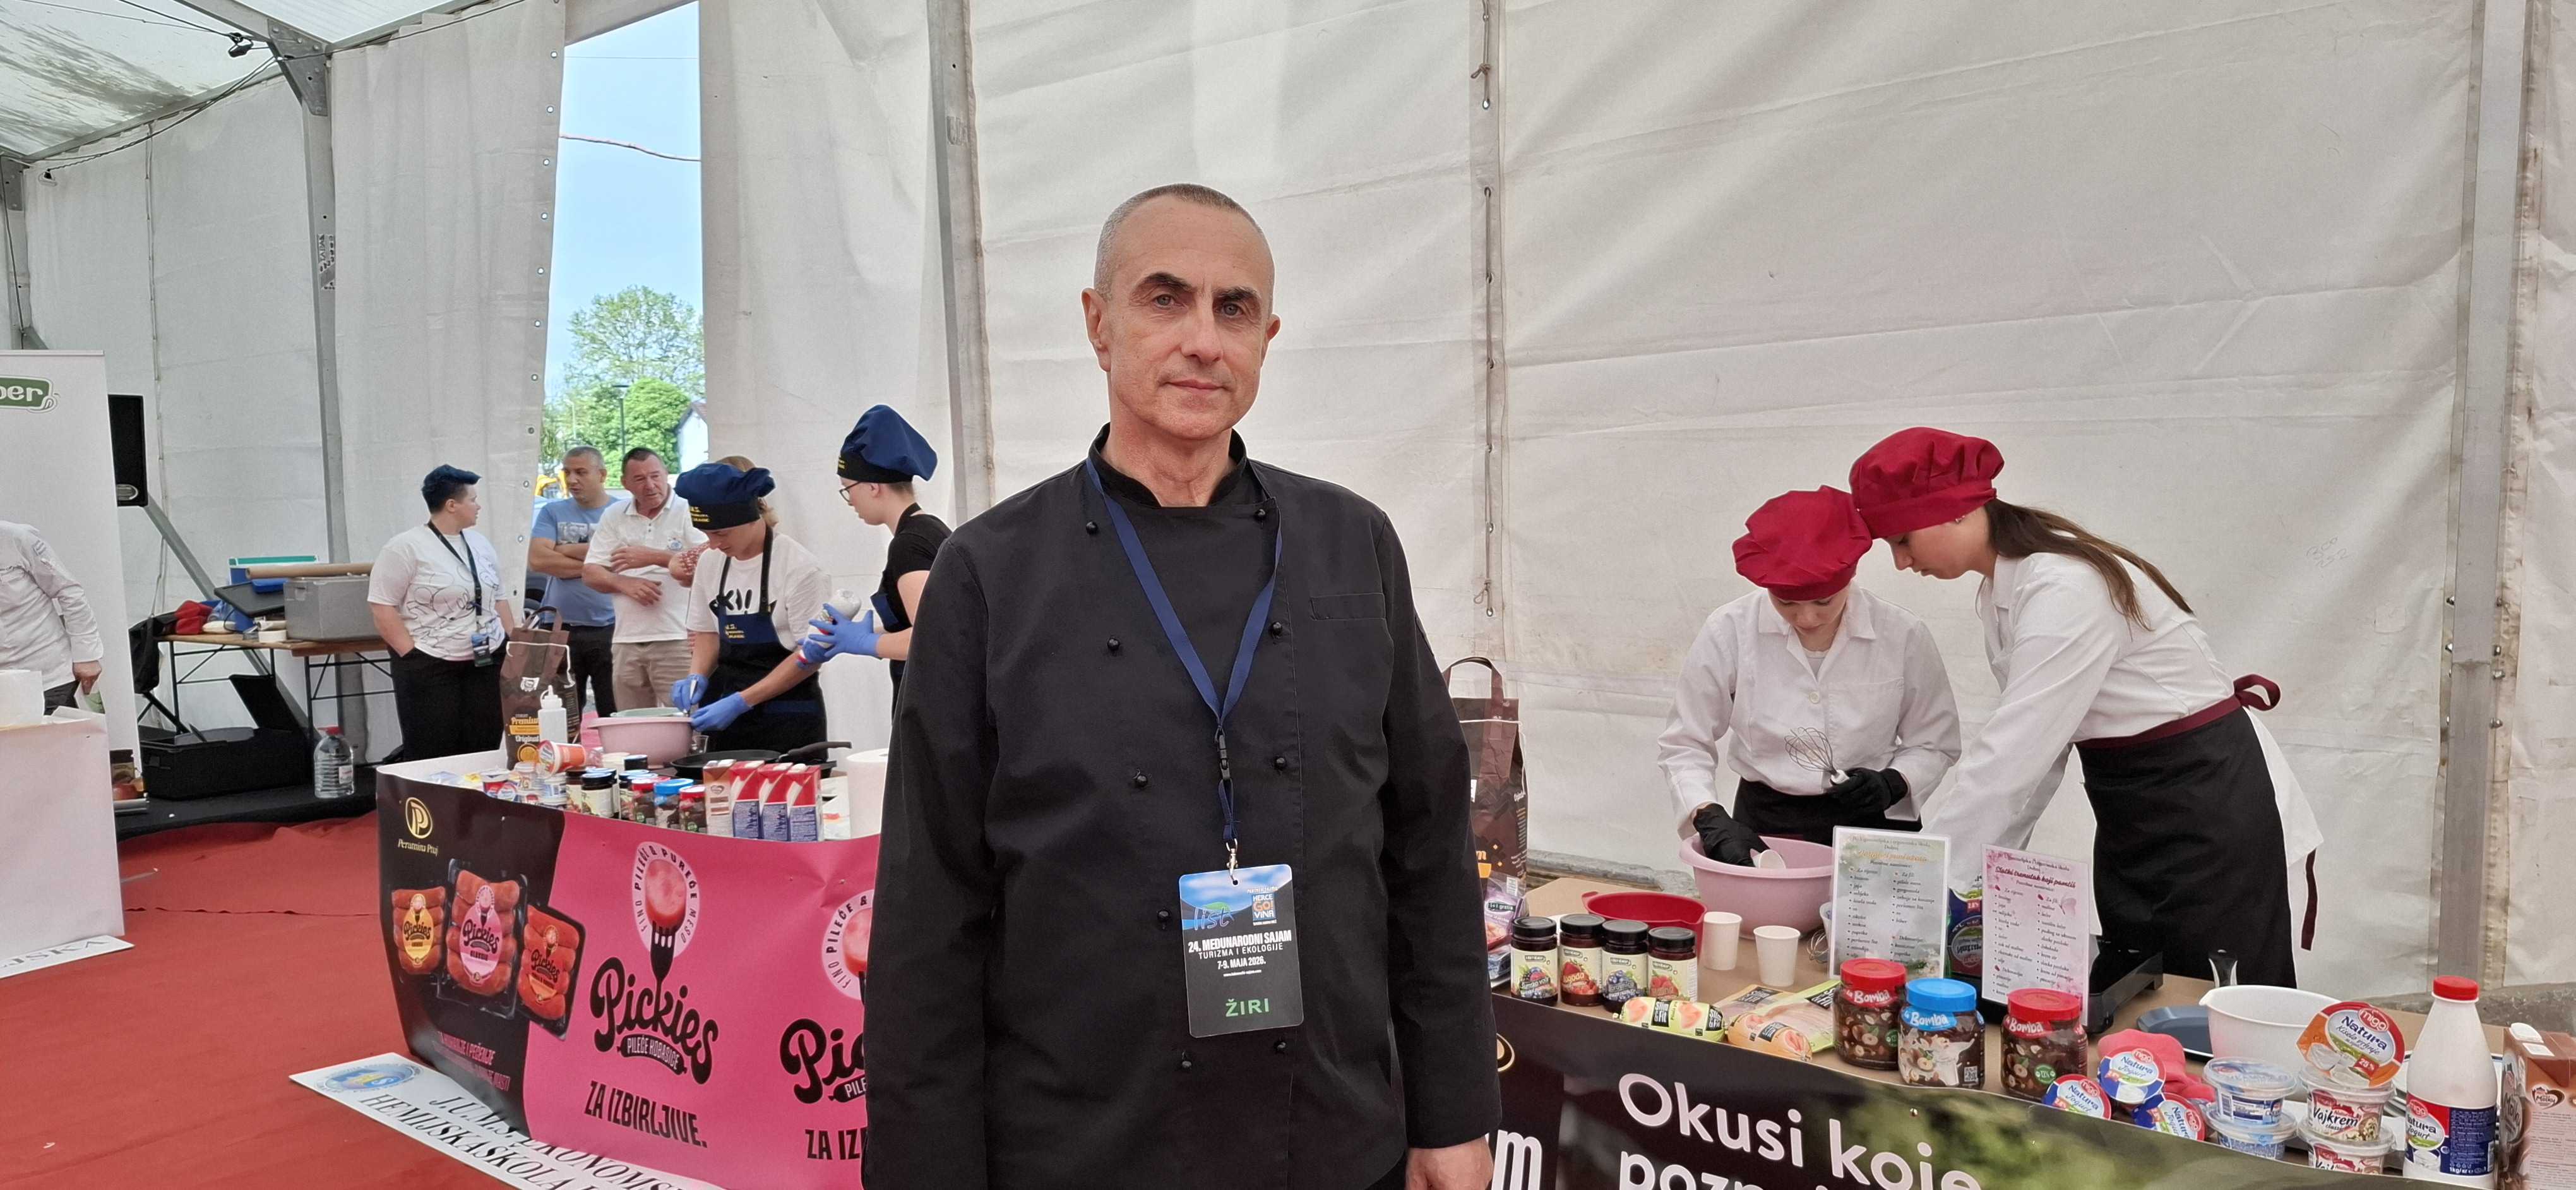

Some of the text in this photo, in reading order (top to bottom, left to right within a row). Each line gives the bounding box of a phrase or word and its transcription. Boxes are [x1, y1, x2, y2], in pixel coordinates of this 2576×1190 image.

[1995, 867, 2013, 875] Slatki
[2014, 871, 2040, 880] trenutak
[403, 920, 431, 941] Pickies
[462, 919, 499, 954] Pickies
[1188, 942, 1202, 953] 24.
[1263, 930, 1292, 944] SAJAM
[1198, 949, 1233, 959] TURIZMA
[1242, 942, 1283, 954] EKOLOGIJE
[531, 949, 560, 982] Pickies
[1217, 956, 1266, 970] 7-9. MAJA 2026.
[1655, 1001, 1669, 1011] Slim
[1854, 989, 1891, 1003] Bomba
[1225, 998, 1269, 1018] ŽIRI
[1659, 1011, 1667, 1023] Fit
[590, 957, 719, 1085] Pickies
[1910, 1011, 1949, 1027] Bomba
[2009, 1018, 2043, 1033] Bomba
[2341, 1016, 2387, 1050] Natura
[650, 1040, 680, 1071] KOBASICE
[2121, 1056, 2153, 1074] Natura
[2068, 1085, 2099, 1110] Natura
[584, 1080, 708, 1148] ZA IZBIRLJIVE.
[1618, 1073, 1804, 1167] Okusi
[2313, 1107, 2358, 1127] Vajkrem
[805, 1129, 833, 1160] ZA
